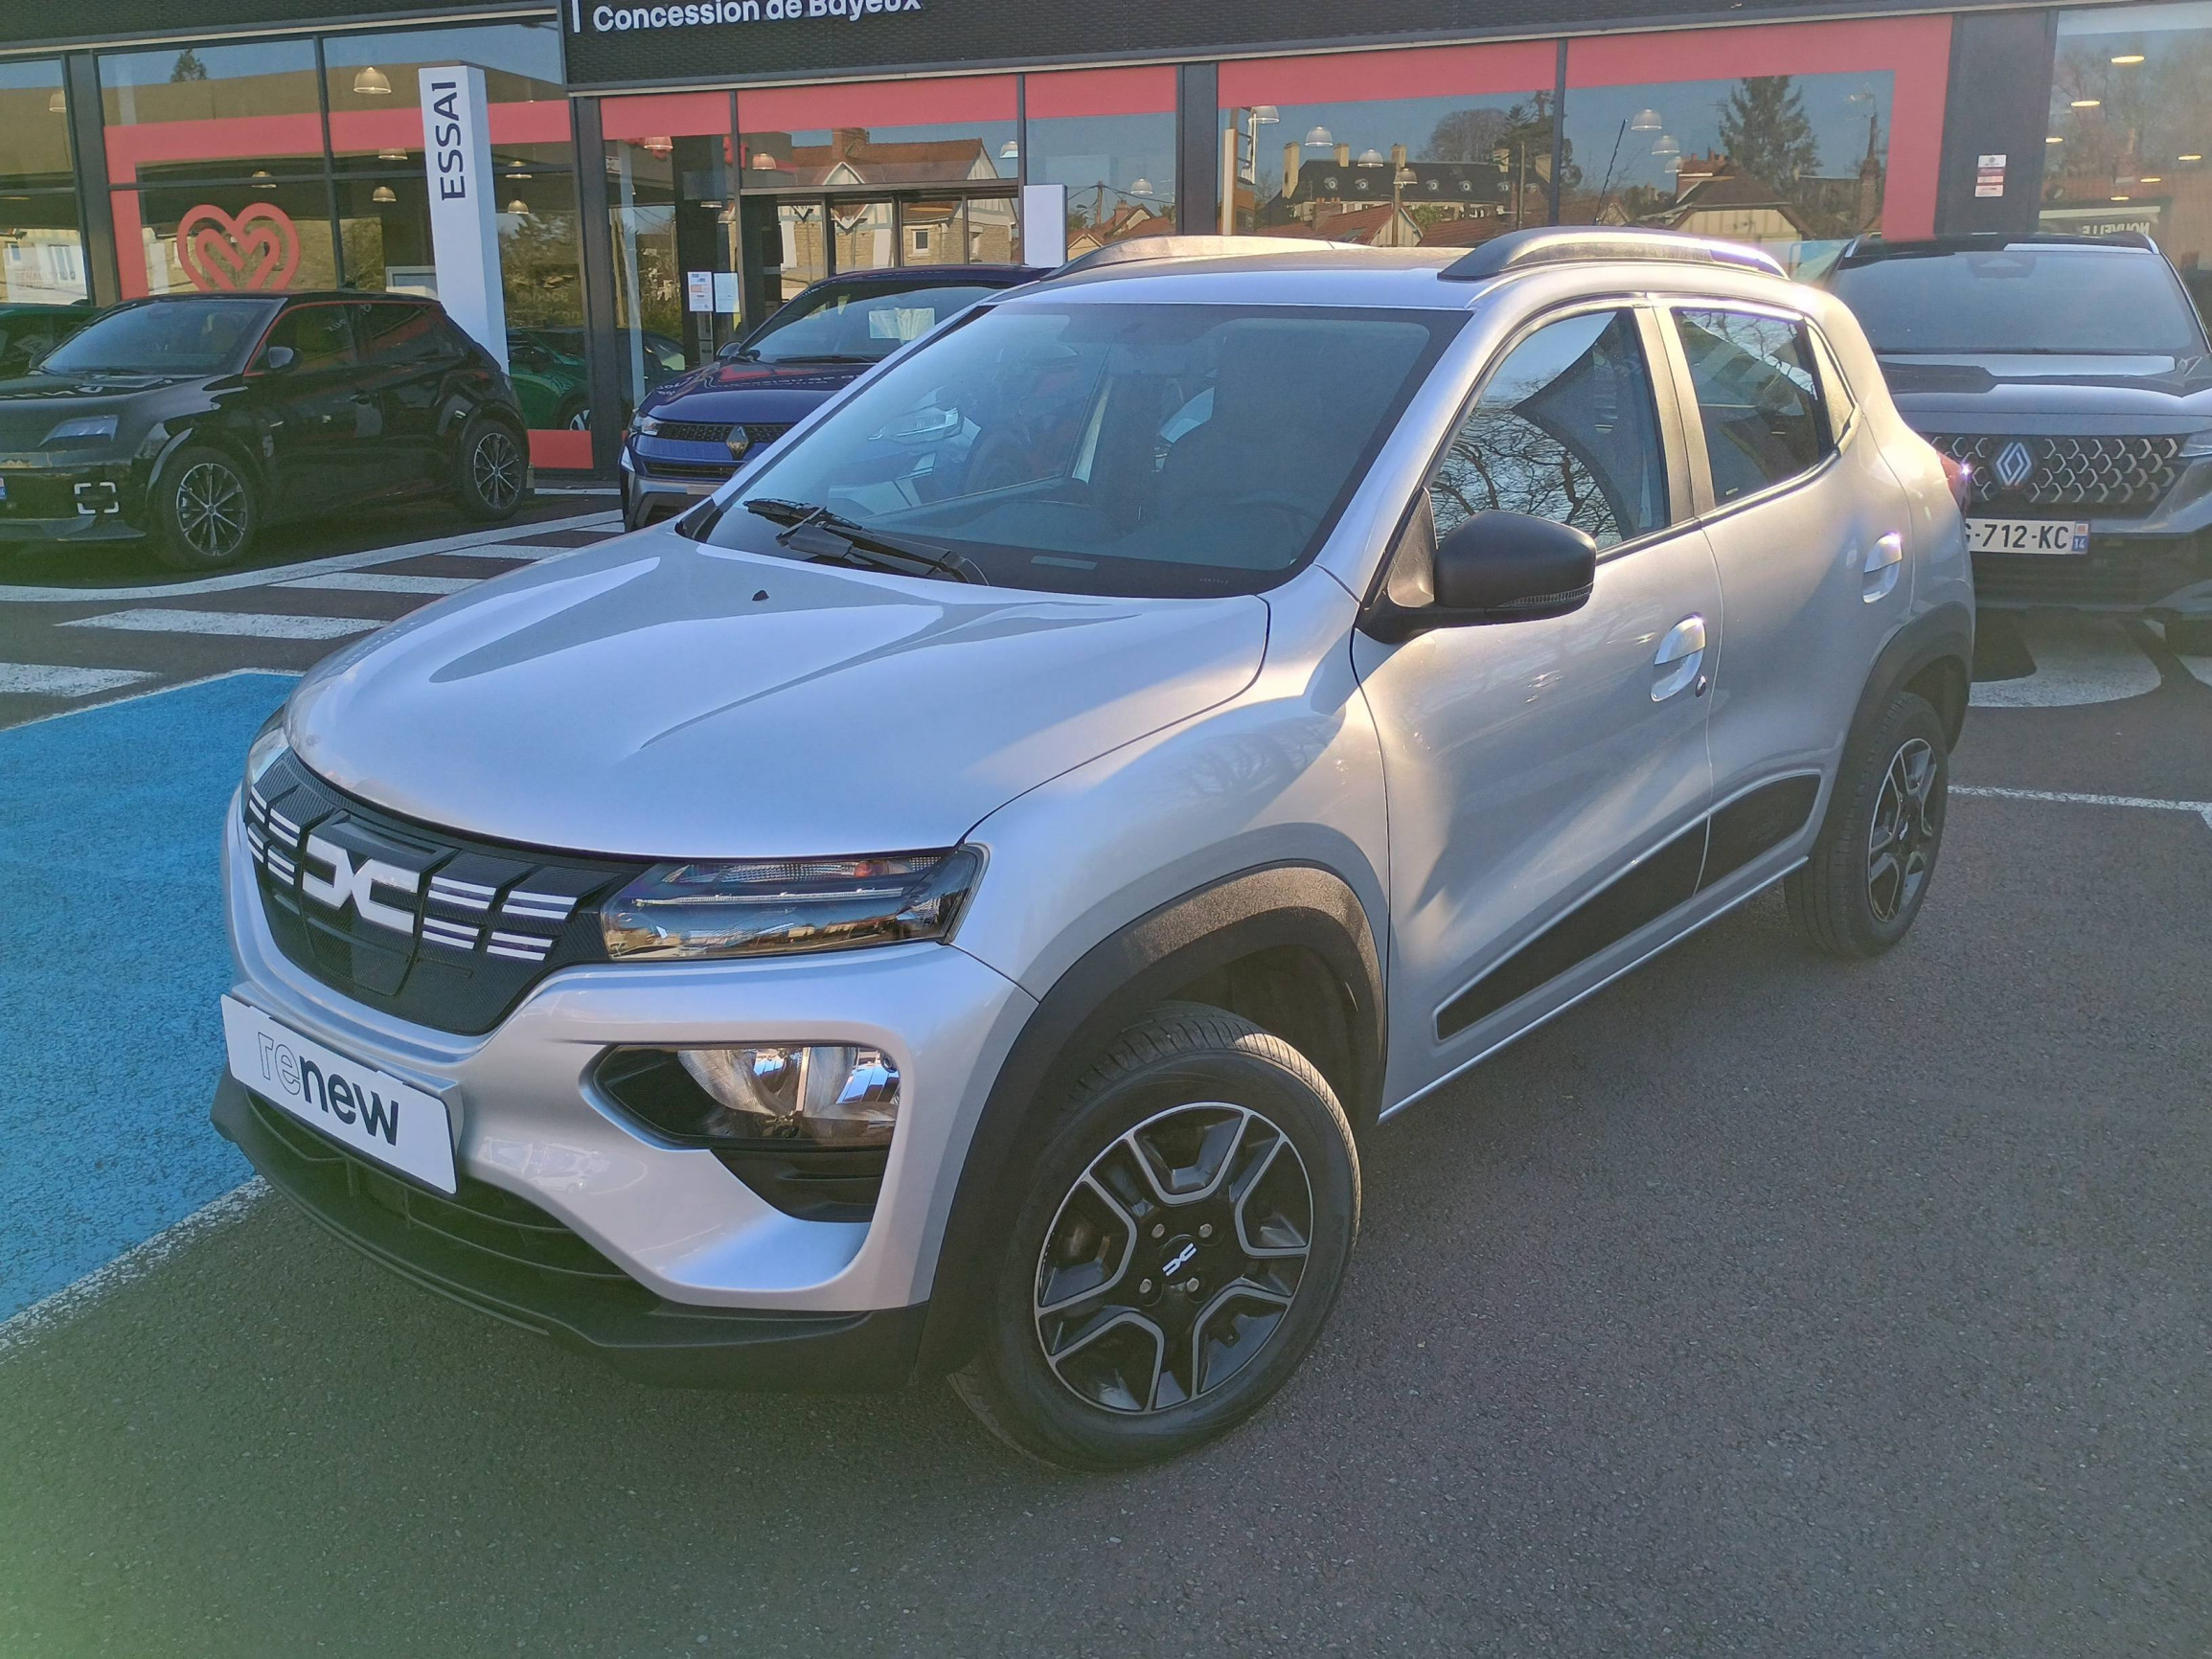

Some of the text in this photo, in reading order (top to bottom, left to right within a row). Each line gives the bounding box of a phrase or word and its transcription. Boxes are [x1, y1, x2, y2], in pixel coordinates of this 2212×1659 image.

[592, 0, 922, 32] Concession de Bayeux
[431, 81, 467, 201] ESSAI
[2073, 537, 2086, 550] 14
[258, 1031, 399, 1147] renew
